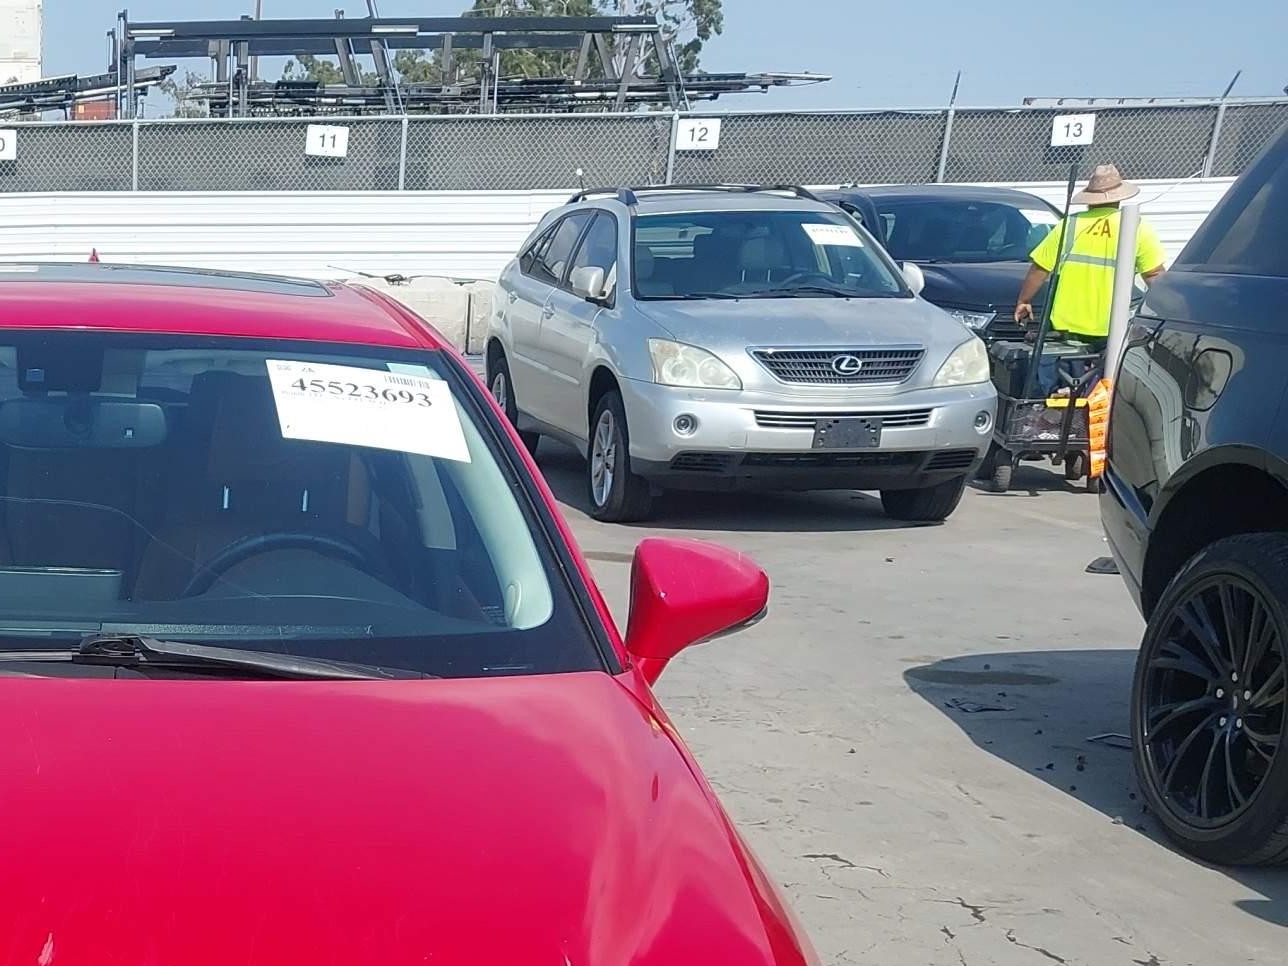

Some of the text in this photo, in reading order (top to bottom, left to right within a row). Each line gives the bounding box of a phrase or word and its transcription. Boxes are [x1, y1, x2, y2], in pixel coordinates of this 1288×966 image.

[690, 127, 708, 142] 12
[1064, 123, 1083, 138] 13
[319, 134, 336, 148] 11
[291, 377, 433, 408] 45523693
